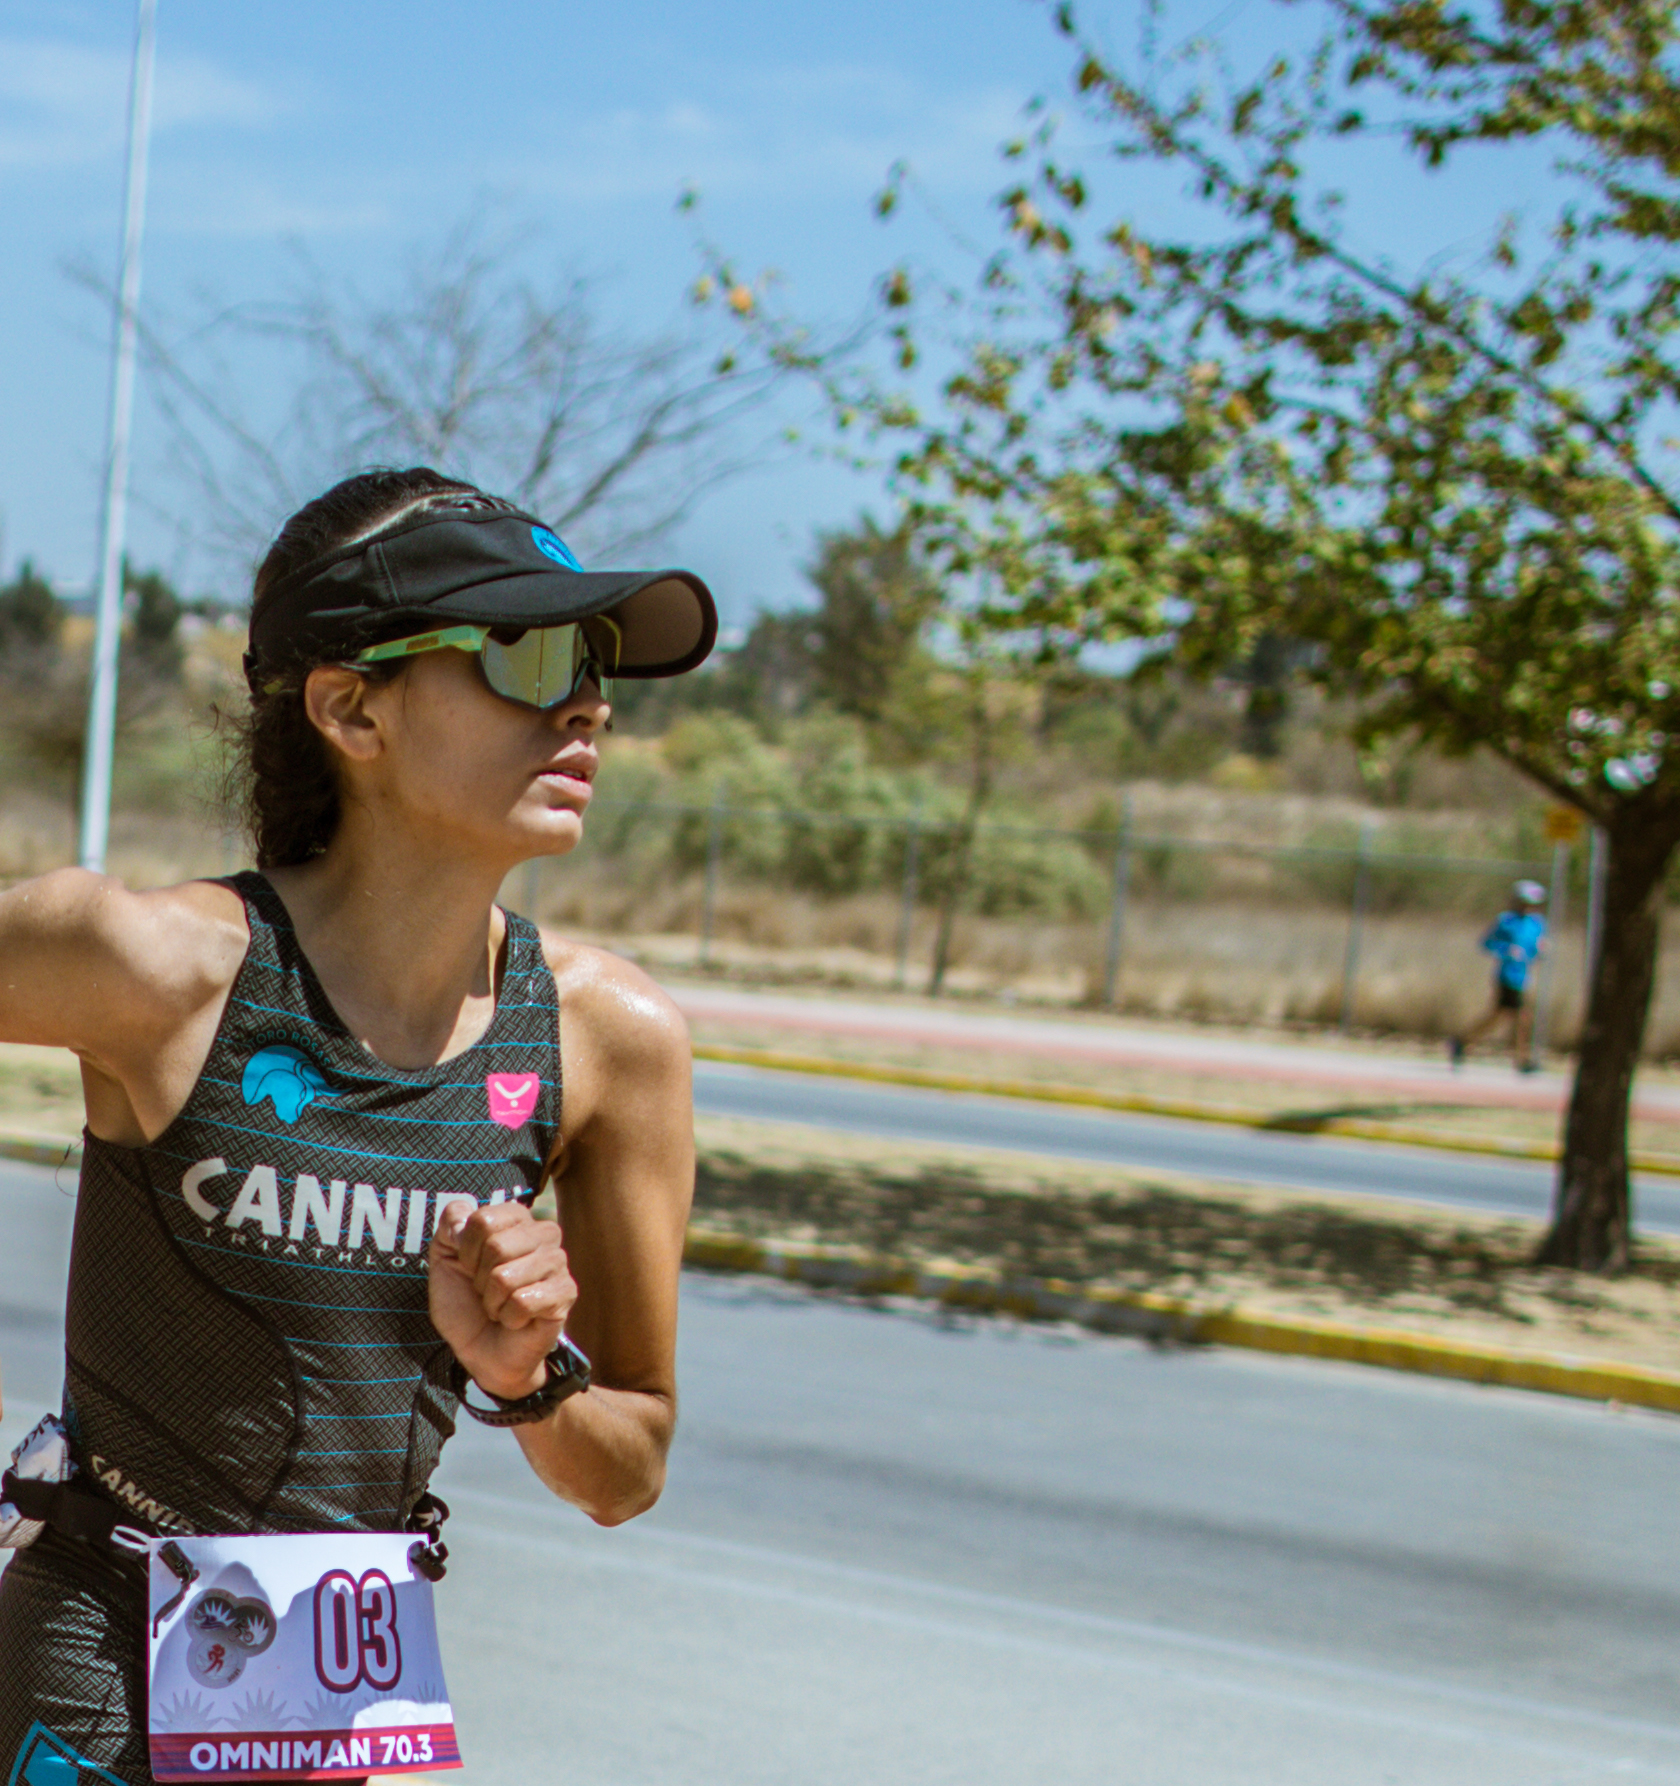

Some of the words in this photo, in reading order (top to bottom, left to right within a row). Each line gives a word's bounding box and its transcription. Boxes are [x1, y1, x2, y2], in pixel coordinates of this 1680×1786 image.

[181, 1156, 522, 1255] CANNI
[313, 1568, 402, 1694] 03
[190, 1737, 372, 1771] OMNIMAN
[379, 1733, 434, 1765] 70.3
